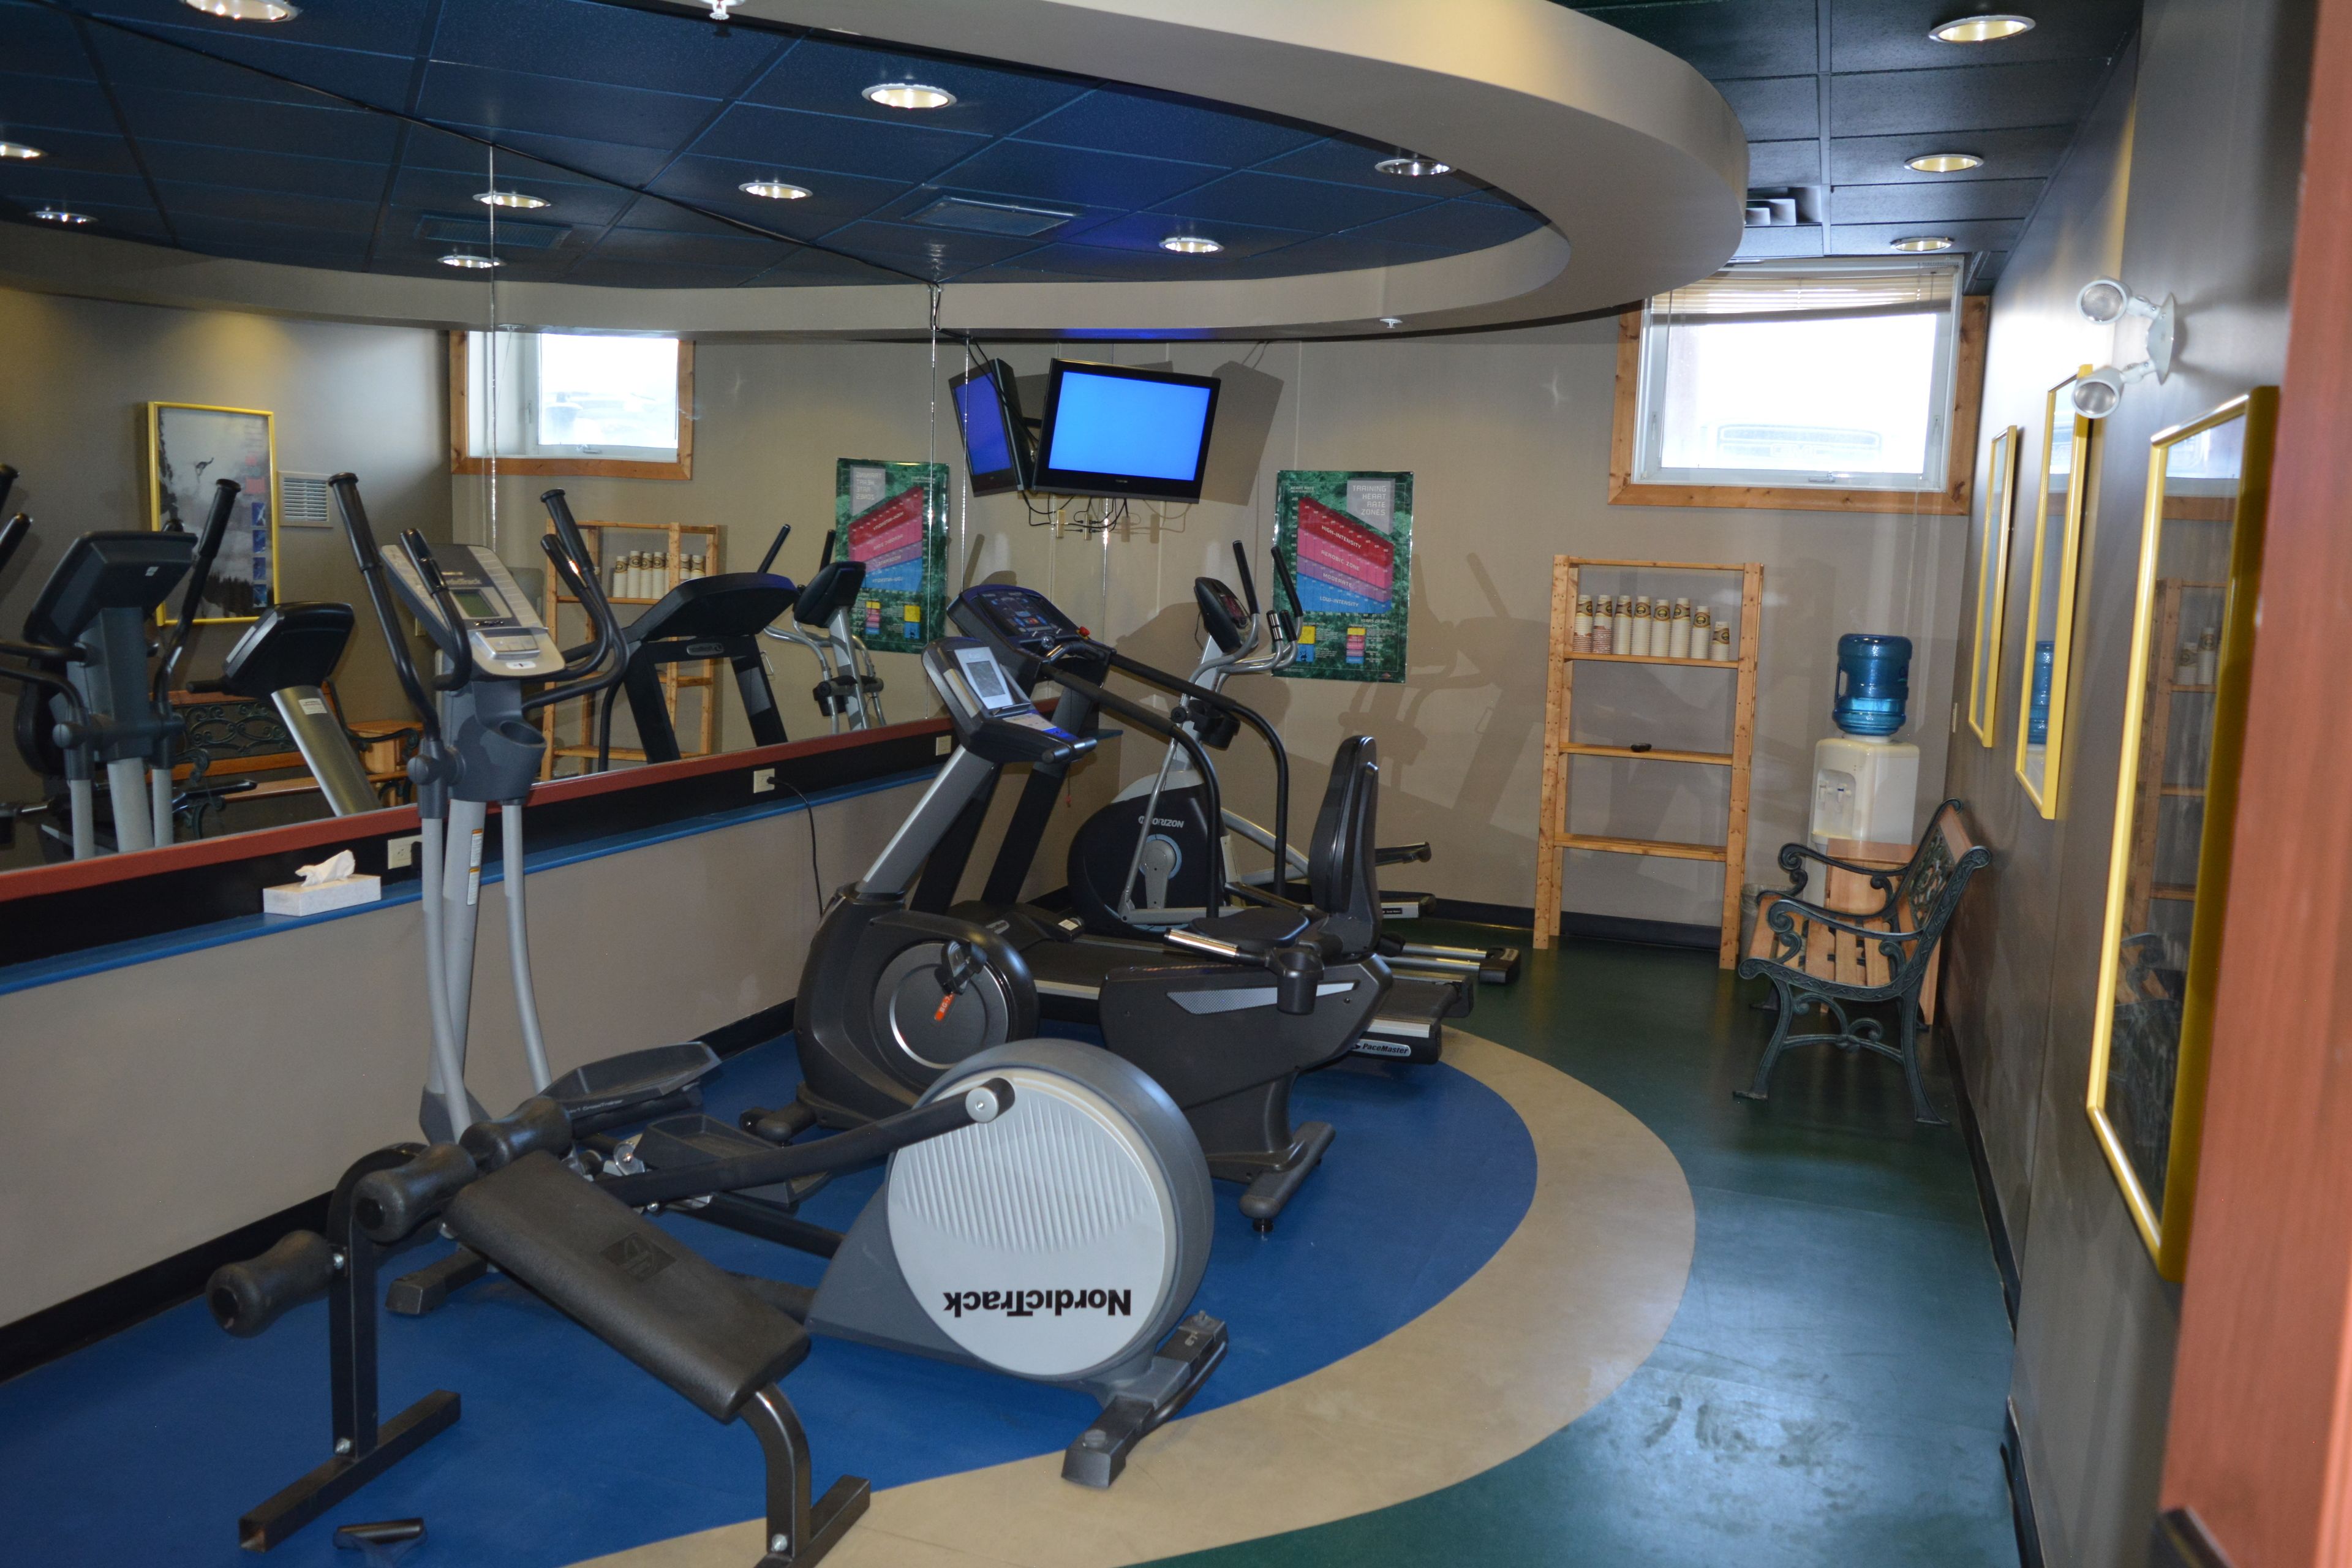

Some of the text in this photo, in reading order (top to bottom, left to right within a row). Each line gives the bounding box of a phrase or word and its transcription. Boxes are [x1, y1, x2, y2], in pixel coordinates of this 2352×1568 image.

[1321, 525, 1362, 549] HIGH-INTENSITY
[1321, 549, 1361, 571] AEROBIC ZONE
[1322, 573, 1353, 588] MODERATE
[1319, 596, 1360, 607] LOW-INTENSITY
[1152, 818, 1185, 829] ORIZON
[1362, 1042, 1409, 1054] PaceMaster
[943, 1289, 1132, 1318] NordicTrack
